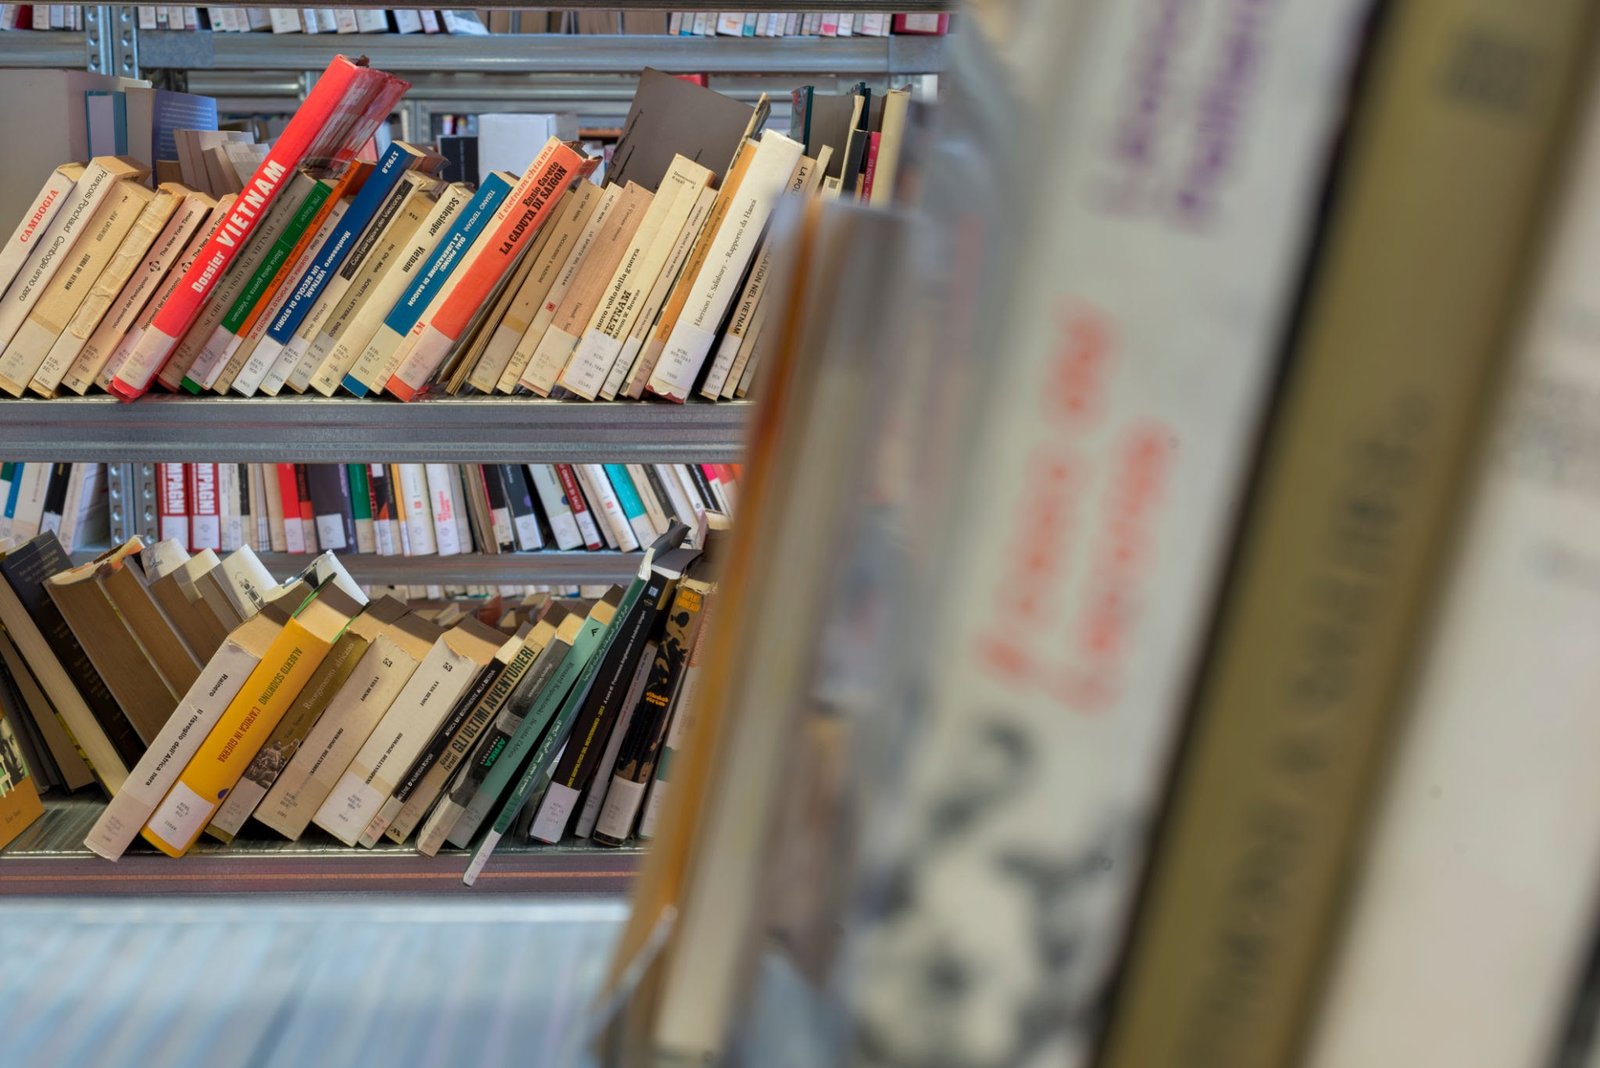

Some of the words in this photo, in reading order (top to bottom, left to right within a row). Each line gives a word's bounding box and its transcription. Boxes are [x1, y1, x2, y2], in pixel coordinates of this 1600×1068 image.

[380, 150, 399, 173] 1792.8
[797, 166, 807, 177] LA
[84, 169, 107, 200] François
[496, 211, 504, 220] il
[501, 178, 528, 213] vietnam
[524, 143, 553, 180] chiama
[522, 185, 540, 206] Ennio
[536, 160, 559, 187] Caretto
[478, 188, 496, 210] TIZIANO
[498, 240, 513, 255] LA
[508, 207, 536, 243] CADUTA
[530, 197, 544, 210] DI
[538, 165, 567, 200] SAIGON
[18, 187, 59, 243] CAMBOGIA
[62, 197, 89, 233] Ponchaud
[190, 249, 226, 293] Dossier
[215, 158, 286, 250] VIETNAM
[426, 195, 460, 236] Schlesinger
[462, 209, 481, 231] TERZANI
[725, 227, 745, 258] Rapporto
[744, 198, 757, 218] Hanoi
[158, 245, 168, 256] The
[165, 235, 175, 247] New
[173, 223, 183, 236] York
[181, 209, 193, 224] Times
[191, 246, 201, 258] The
[198, 236, 209, 248] New
[205, 224, 217, 237] York
[213, 210, 226, 226] Times
[453, 232, 461, 241] LA
[38, 234, 65, 269] Cambogia
[227, 270, 244, 291] VISTO
[242, 255, 254, 270] NEL
[252, 224, 275, 256] VIETNAM
[270, 248, 284, 265] Storia
[323, 229, 350, 267] Montessoro
[401, 244, 426, 273] Vietnam
[427, 240, 456, 278] LIBERAZIONE
[27, 268, 42, 286] anno
[261, 264, 273, 279] della
[286, 275, 296, 286] DEL
[309, 264, 319, 275] UN
[604, 291, 618, 309] volto
[613, 272, 627, 291] della
[623, 247, 640, 274] guerra
[17, 285, 31, 301] zero
[129, 274, 150, 301] Pentagono
[248, 276, 263, 295] guerra
[272, 286, 288, 307] POPOLO
[294, 275, 313, 300] SECOLO
[407, 283, 424, 306] SAIGON
[694, 299, 711, 326] Harrison
[706, 291, 714, 299] E.
[710, 263, 729, 291] Salisbury
[747, 284, 758, 299] NEL
[230, 300, 248, 322] Vietnam
[288, 299, 297, 308] DI
[732, 300, 751, 334] VIETNAM
[255, 306, 274, 332] ESERCITO
[273, 307, 292, 332] STORIA
[279, 646, 303, 676] ALBERTO
[208, 672, 229, 698] Rainero
[257, 672, 285, 705] SCIORTINO
[301, 666, 336, 710] Risorgimento
[451, 734, 470, 753] GLI
[462, 706, 490, 738] ULTIMI
[482, 645, 535, 710] AVVENTURIERI
[176, 714, 198, 741] risveglio
[237, 705, 260, 733] L'AFRICA
[233, 730, 243, 740] IN
[155, 741, 180, 773] dell'Africa
[216, 737, 238, 763] GUERRA
[483, 737, 506, 767] AFRICA
[144, 771, 157, 787] nera
